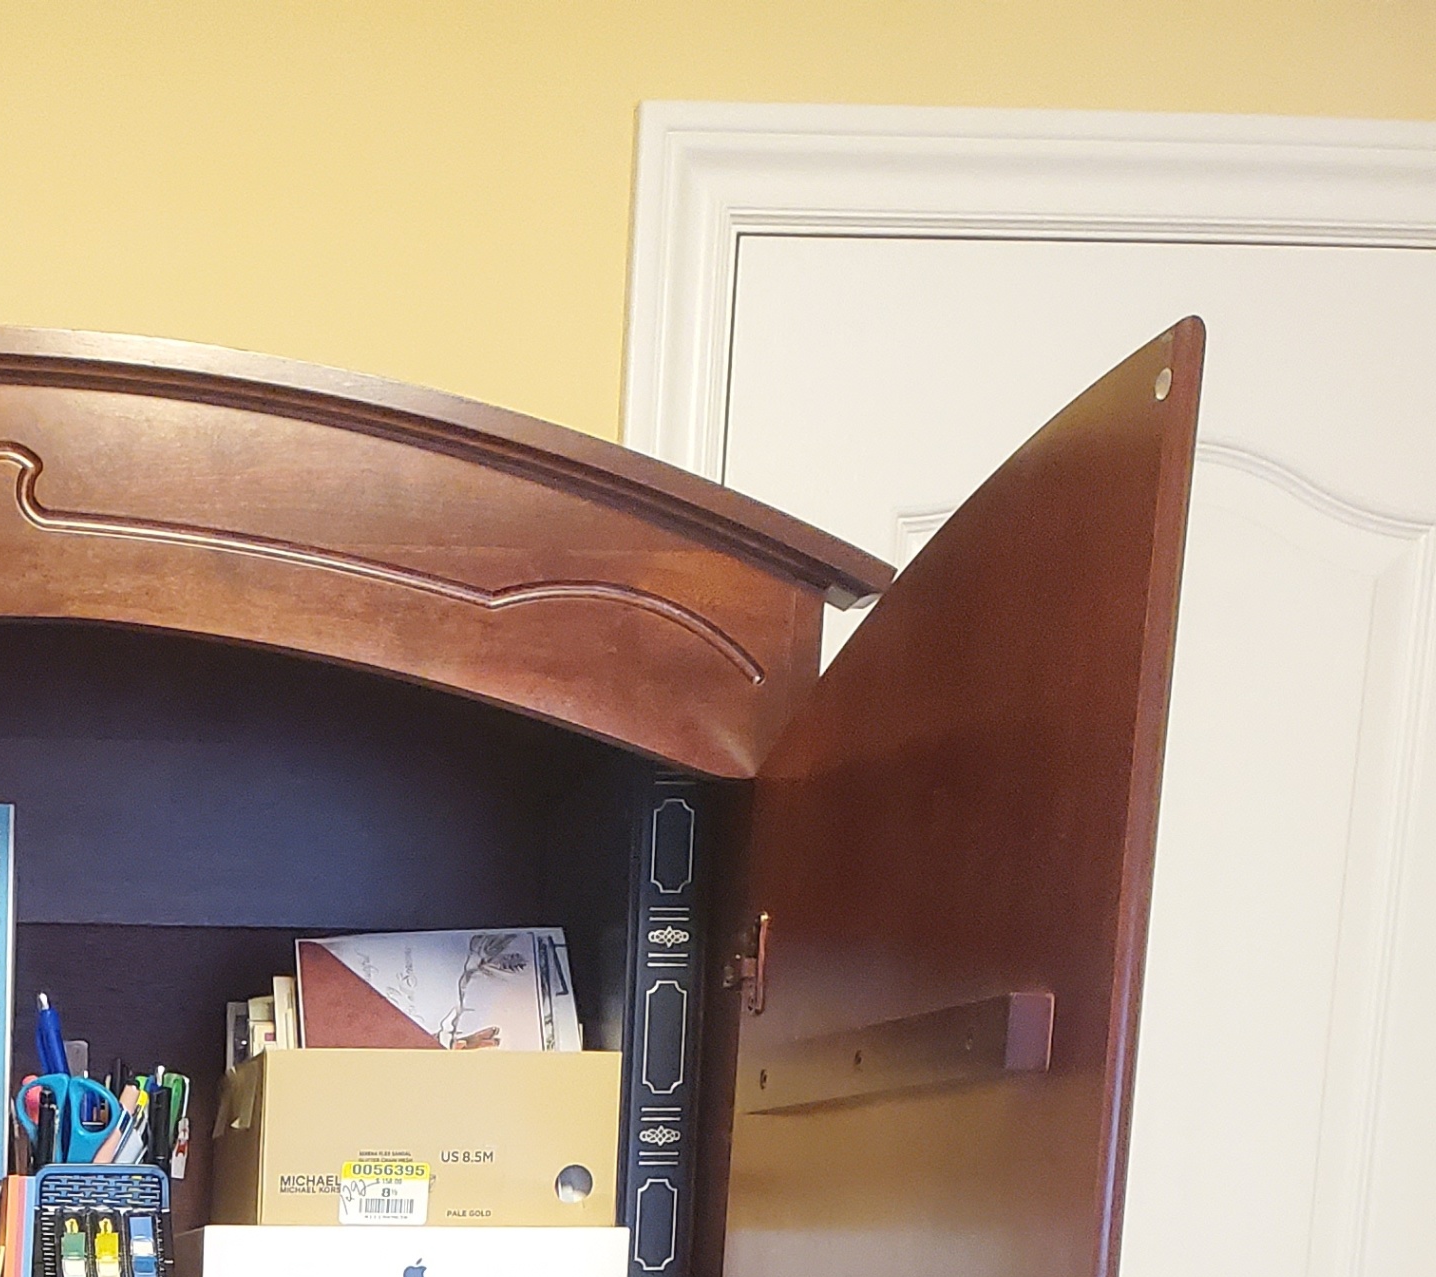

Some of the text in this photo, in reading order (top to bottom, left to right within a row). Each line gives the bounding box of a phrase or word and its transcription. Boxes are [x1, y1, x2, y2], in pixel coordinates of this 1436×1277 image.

[441, 1151, 494, 1163] US 8.5M
[352, 1164, 425, 1176] 0056395
[280, 1175, 341, 1186] MICHAEL
